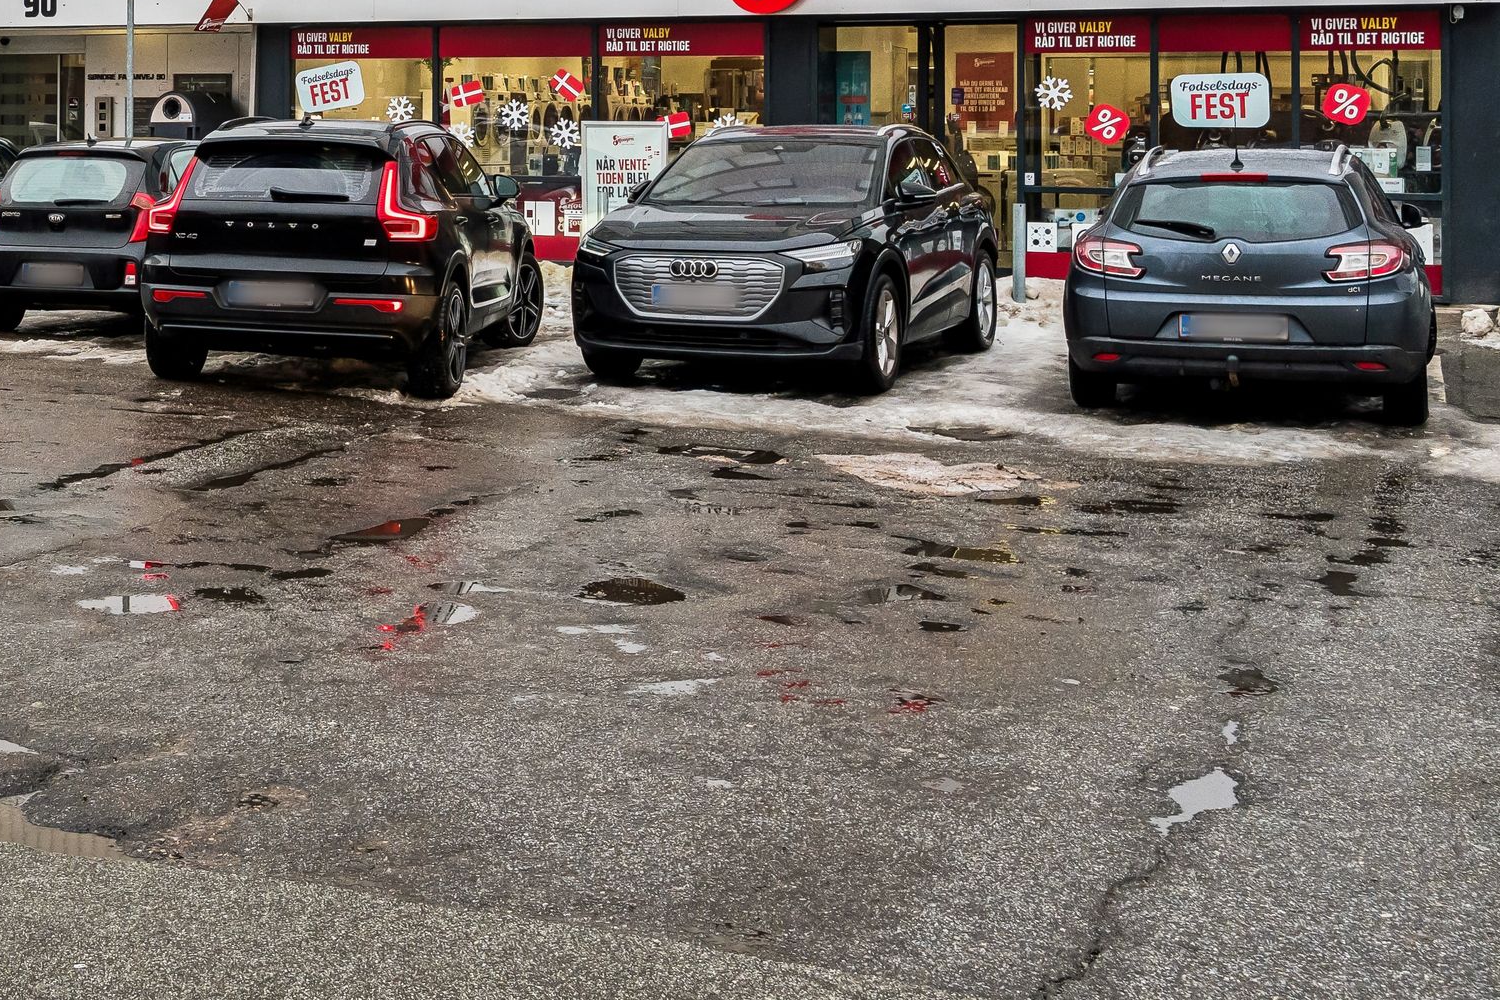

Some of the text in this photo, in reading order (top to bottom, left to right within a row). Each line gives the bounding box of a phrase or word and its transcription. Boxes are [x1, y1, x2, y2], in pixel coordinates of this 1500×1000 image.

[1035, 22, 1112, 33] VI GIVER VALBY
[1311, 17, 1397, 30] VI GIVER VALBY
[297, 32, 353, 42] VI GIVER VALBY
[606, 28, 670, 38] VI GIVER VALBY
[1311, 30, 1425, 45] RÅD TIL DET RIGTIGE
[606, 38, 690, 51] RÅD TIL DET RIGTIGE
[1035, 33, 1136, 47] RÅD TIL DET RIGTIGE
[297, 42, 369, 54] RÅD TIL DET RIGTIGE
[309, 78, 350, 106] FEST
[1180, 80, 1262, 93] Fødselsdags-
[1190, 92, 1250, 119] FEST
[596, 155, 650, 170] NÅR VENTE-
[597, 173, 623, 184] TIDEN
[225, 220, 319, 230] VOLVO
